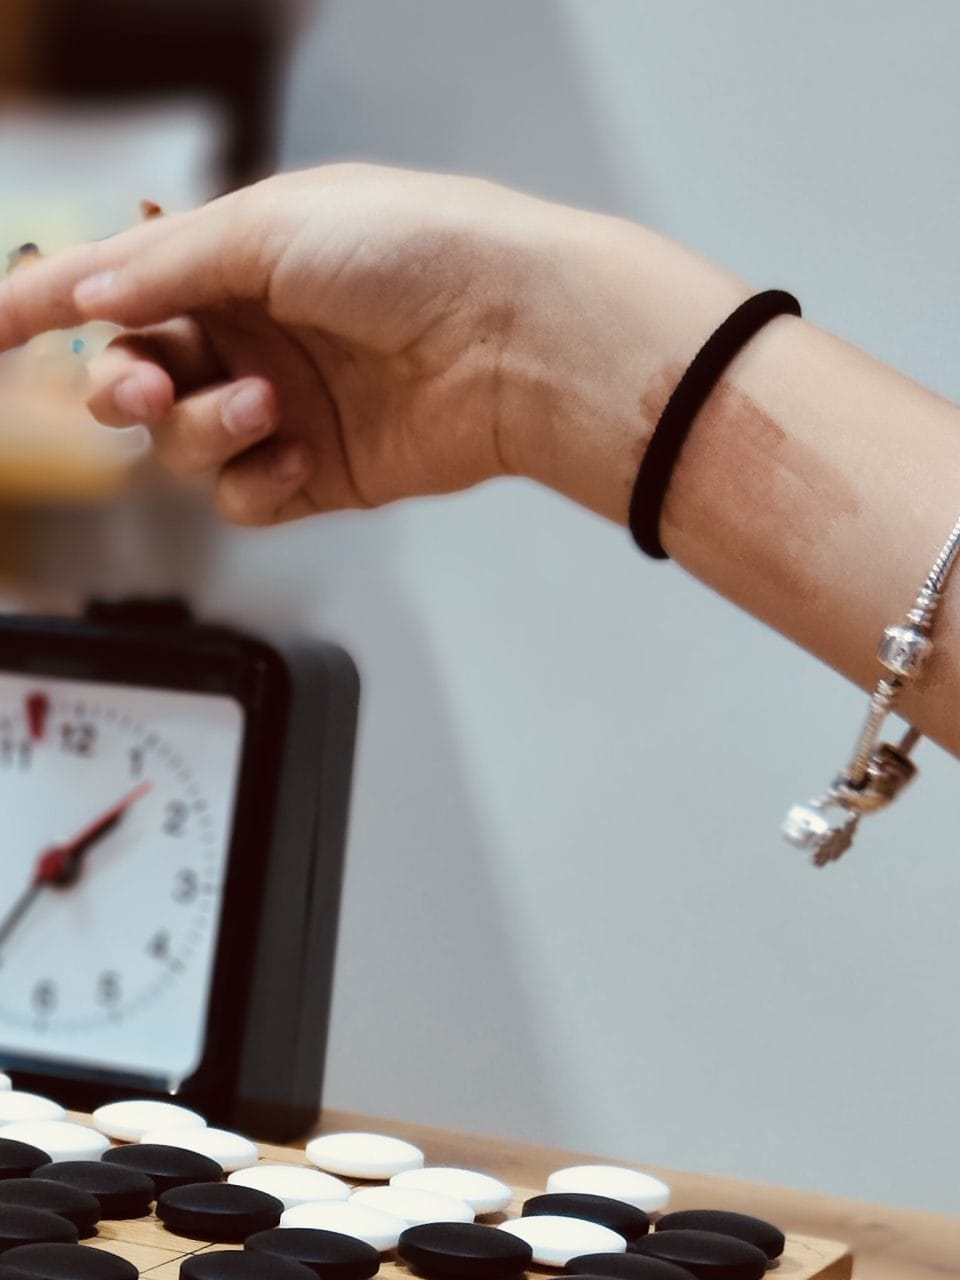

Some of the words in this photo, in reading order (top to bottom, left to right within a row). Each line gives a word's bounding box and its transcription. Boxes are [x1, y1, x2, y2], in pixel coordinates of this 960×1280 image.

[62, 723, 96, 757] 12
[164, 801, 188, 837] 2
[173, 868, 198, 904] 3
